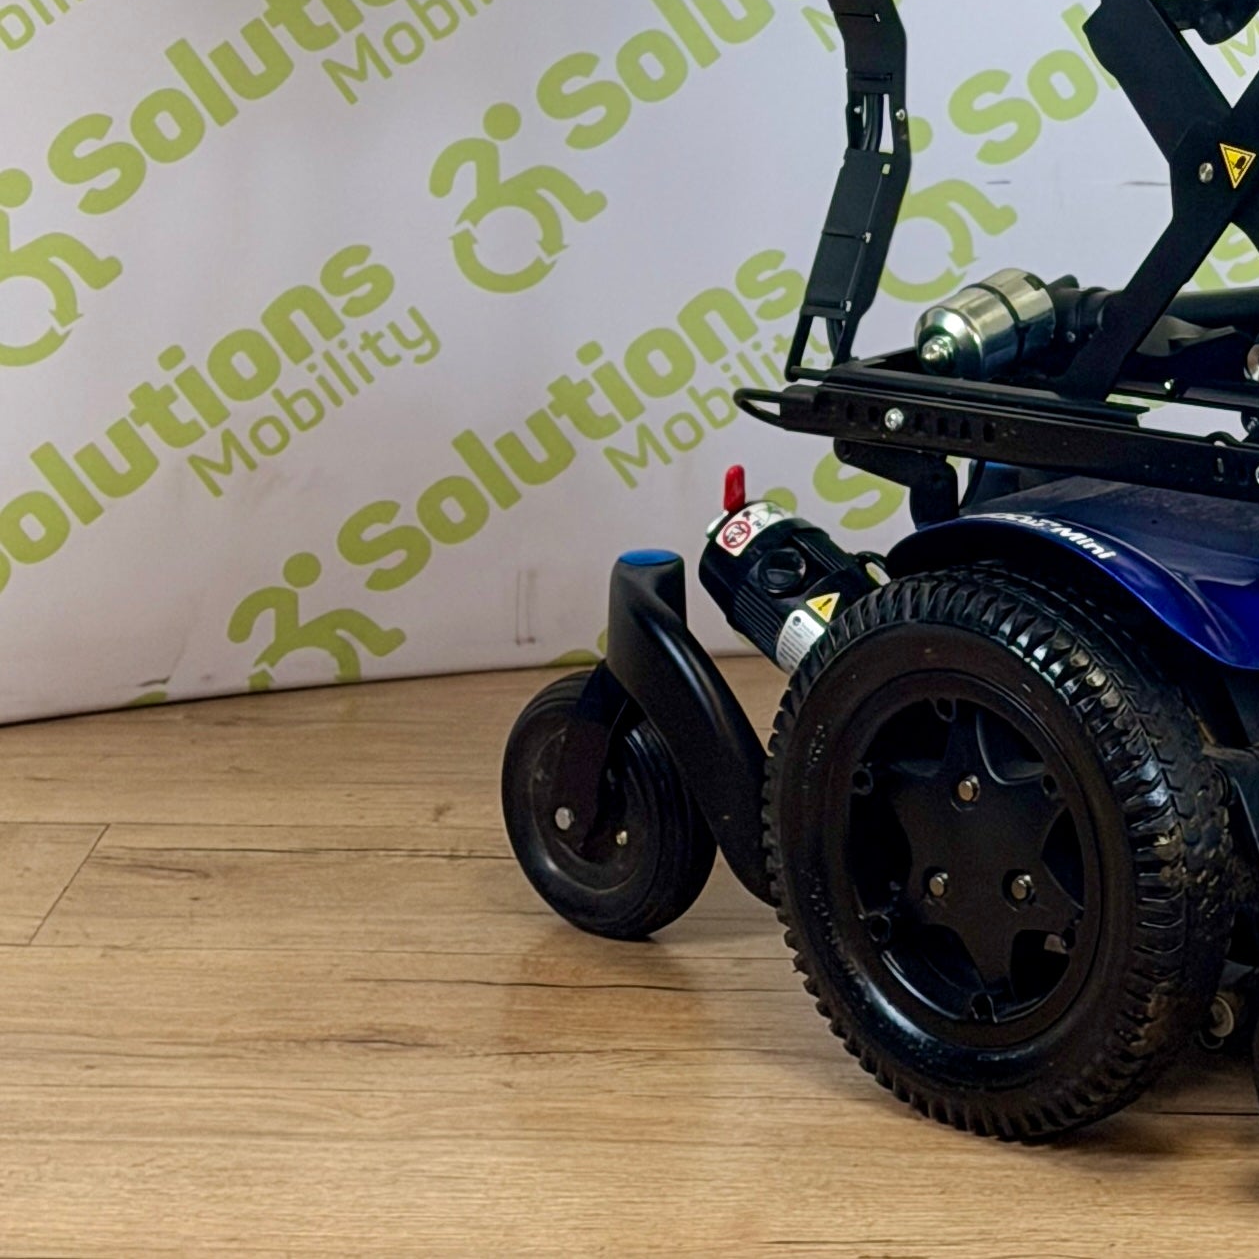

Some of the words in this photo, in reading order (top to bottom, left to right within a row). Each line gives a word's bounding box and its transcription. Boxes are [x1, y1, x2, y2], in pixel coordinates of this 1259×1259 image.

[0, 244, 395, 594] olutions
[187, 306, 442, 497] Mobility
[337, 249, 806, 591] Solutions
